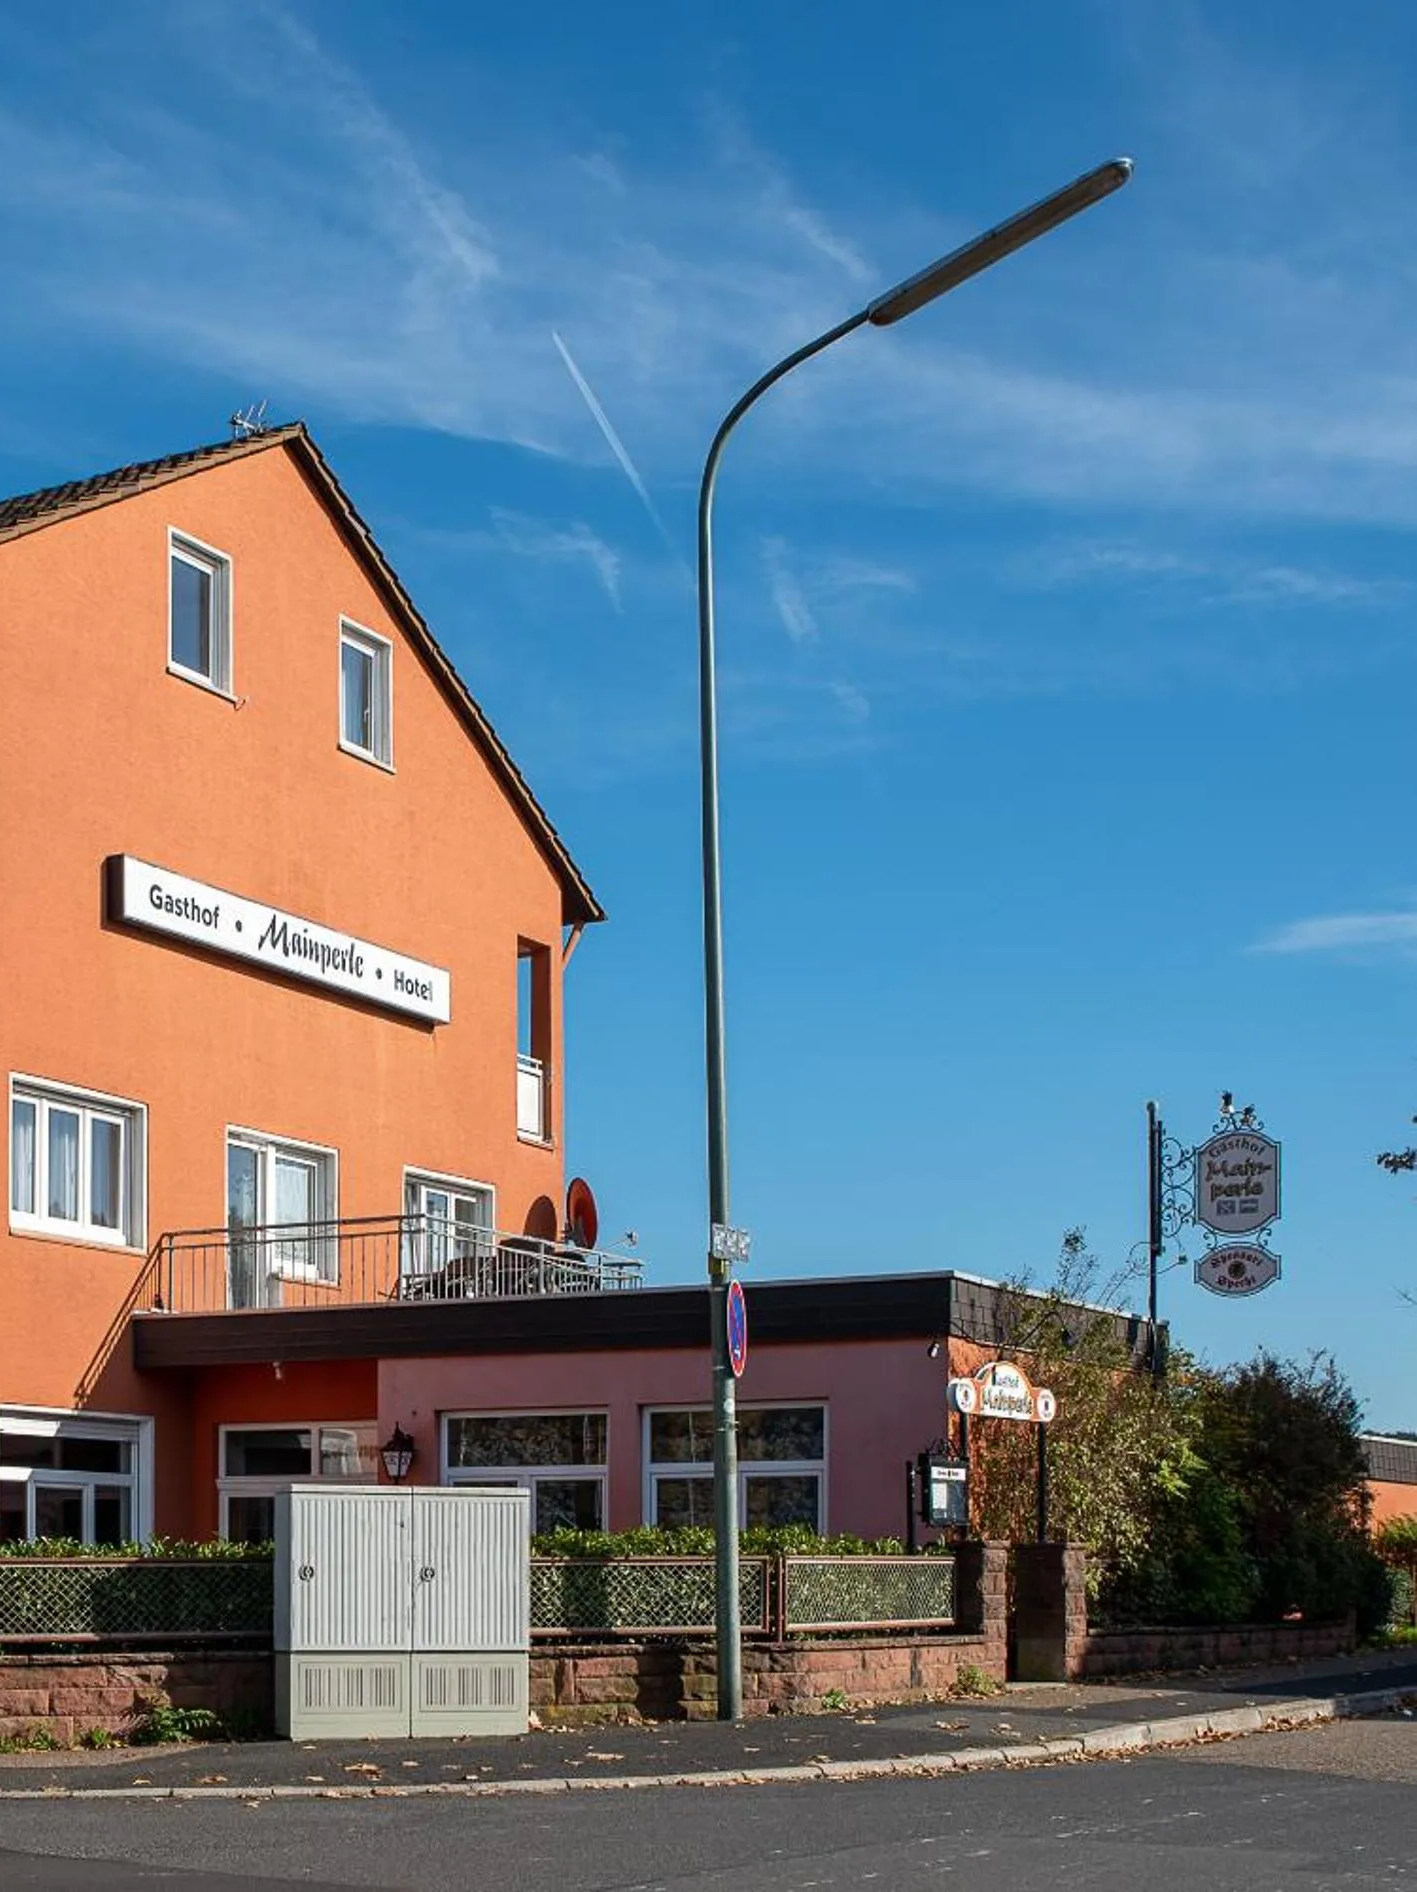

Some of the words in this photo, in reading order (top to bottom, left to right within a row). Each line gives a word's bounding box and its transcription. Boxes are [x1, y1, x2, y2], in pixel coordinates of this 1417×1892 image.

[149, 884, 220, 929] Gasthof
[258, 913, 364, 979] Mainperle
[394, 969, 433, 1003] Hotel
[1208, 1137, 1267, 1157] Gasthof
